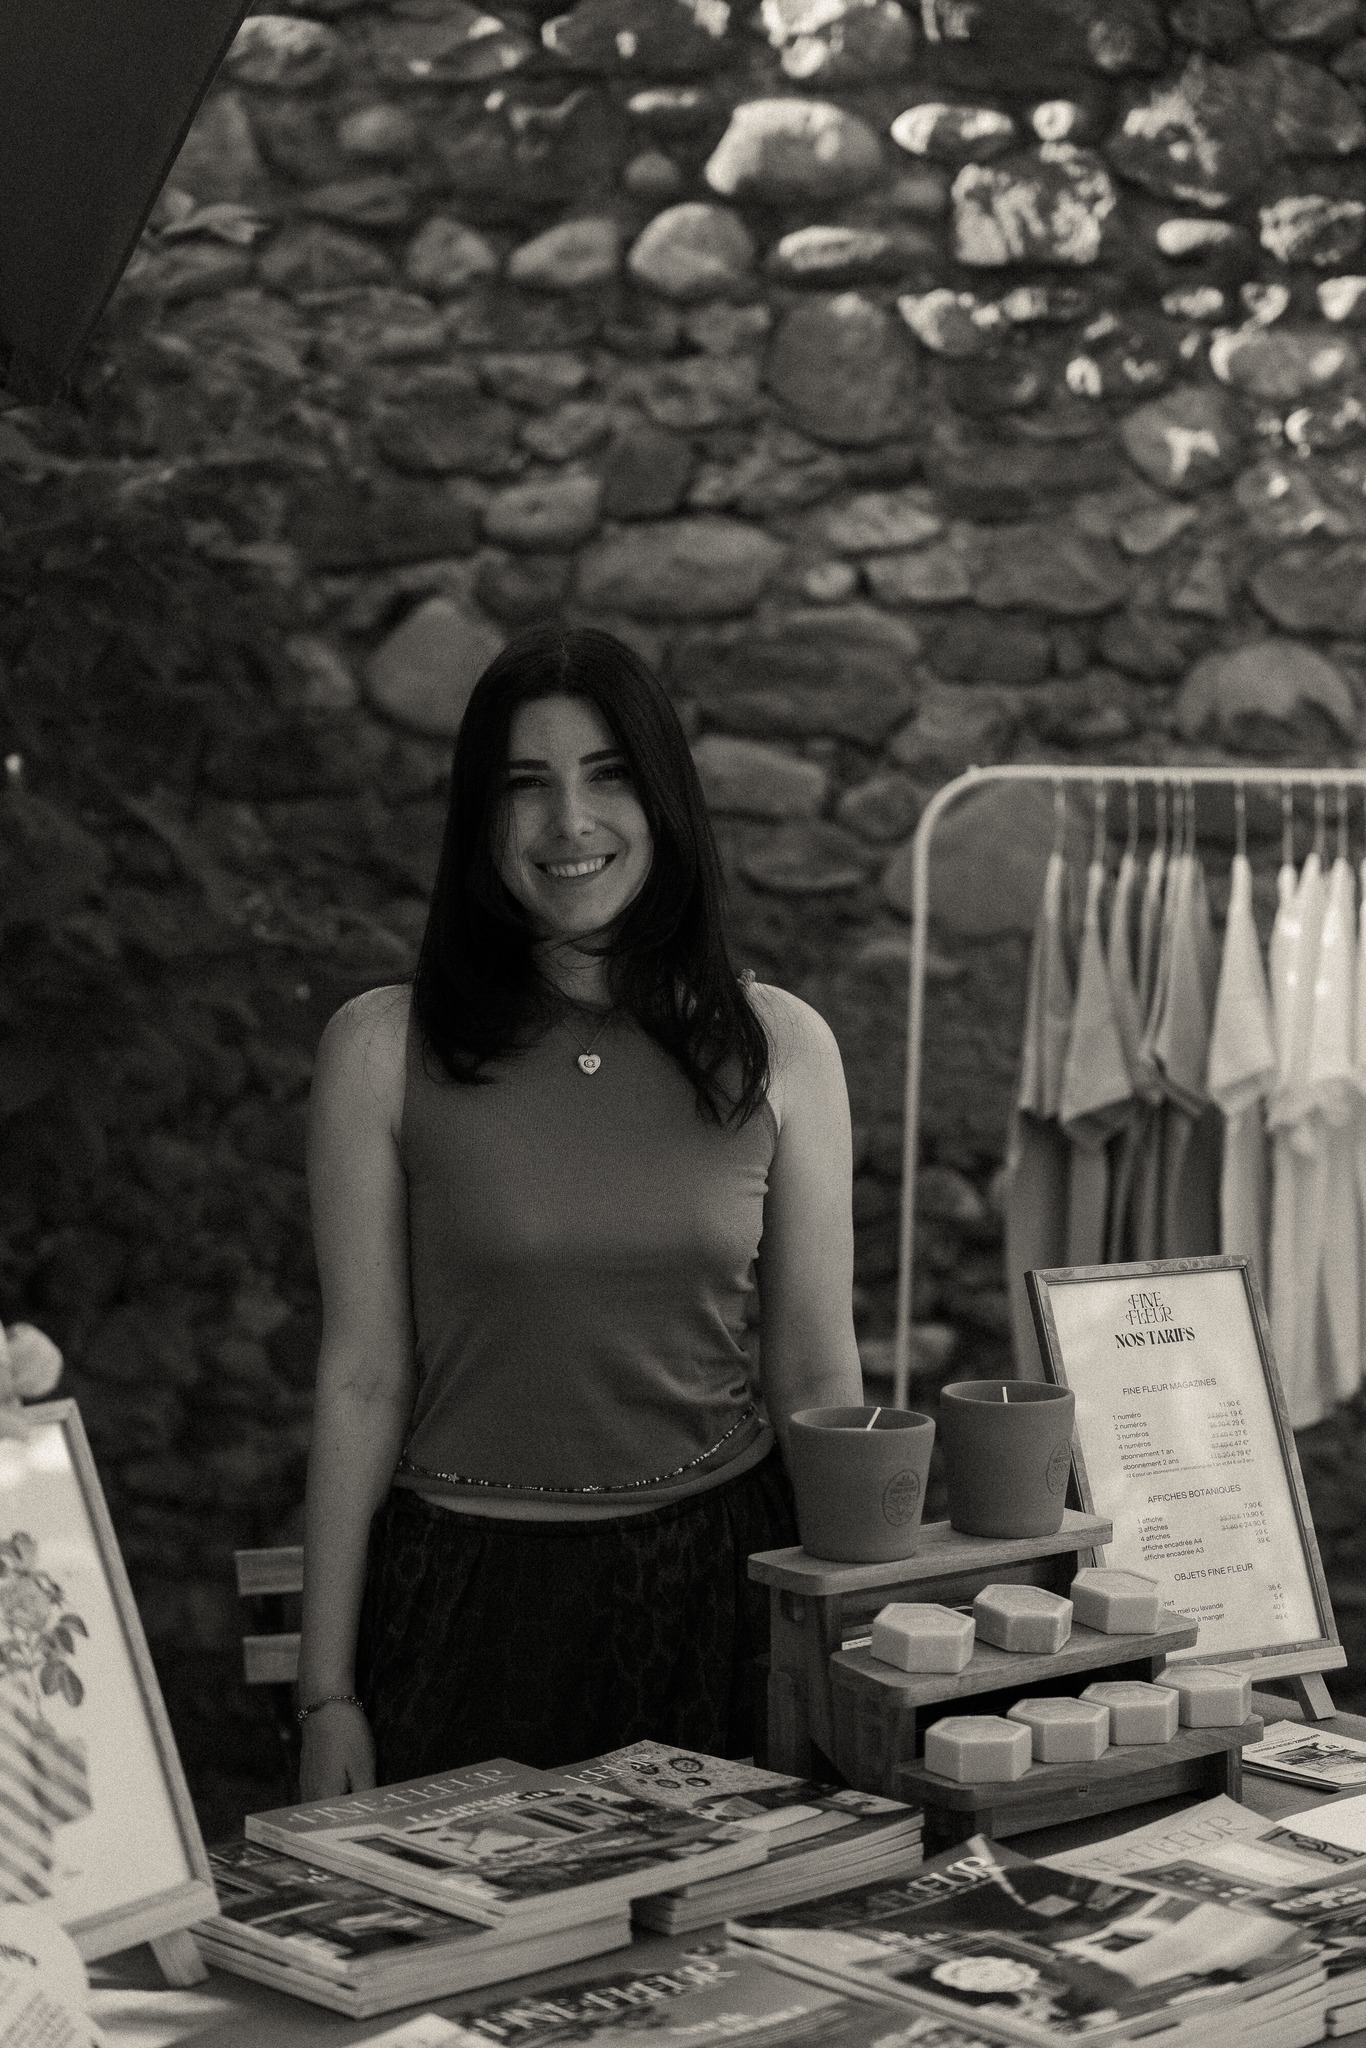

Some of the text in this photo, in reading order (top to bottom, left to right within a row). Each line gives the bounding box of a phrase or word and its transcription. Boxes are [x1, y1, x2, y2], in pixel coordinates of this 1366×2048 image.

[1128, 1292, 1164, 1310] FINE
[1125, 1306, 1174, 1325] FLEUR
[1114, 1326, 1196, 1349] NOS TARIFS
[1122, 1378, 1217, 1396] FINE FLEUR MAGAZINES
[1118, 1412, 1142, 1420] numéro
[1120, 1421, 1147, 1429] numéros
[1122, 1431, 1149, 1440] numéros
[1124, 1441, 1151, 1450] numéros
[1121, 1450, 1159, 1460] abonnement
[1123, 1460, 1162, 1470] abonnement
[1147, 1484, 1242, 1503] AFFICHES BOTANIQUES
[1142, 1516, 1163, 1524] affiche
[1144, 1524, 1168, 1533] affiches
[1146, 1533, 1170, 1542] affiches
[1142, 1544, 1163, 1552] affiche
[1164, 1539, 1193, 1549] encadrée
[1144, 1552, 1165, 1561] affiche
[1166, 1548, 1194, 1558] encadrée
[1174, 1563, 1254, 1581] OBJETS FINE FLEUR
[1200, 1602, 1224, 1612] lavande
[1202, 1613, 1225, 1623] manger
